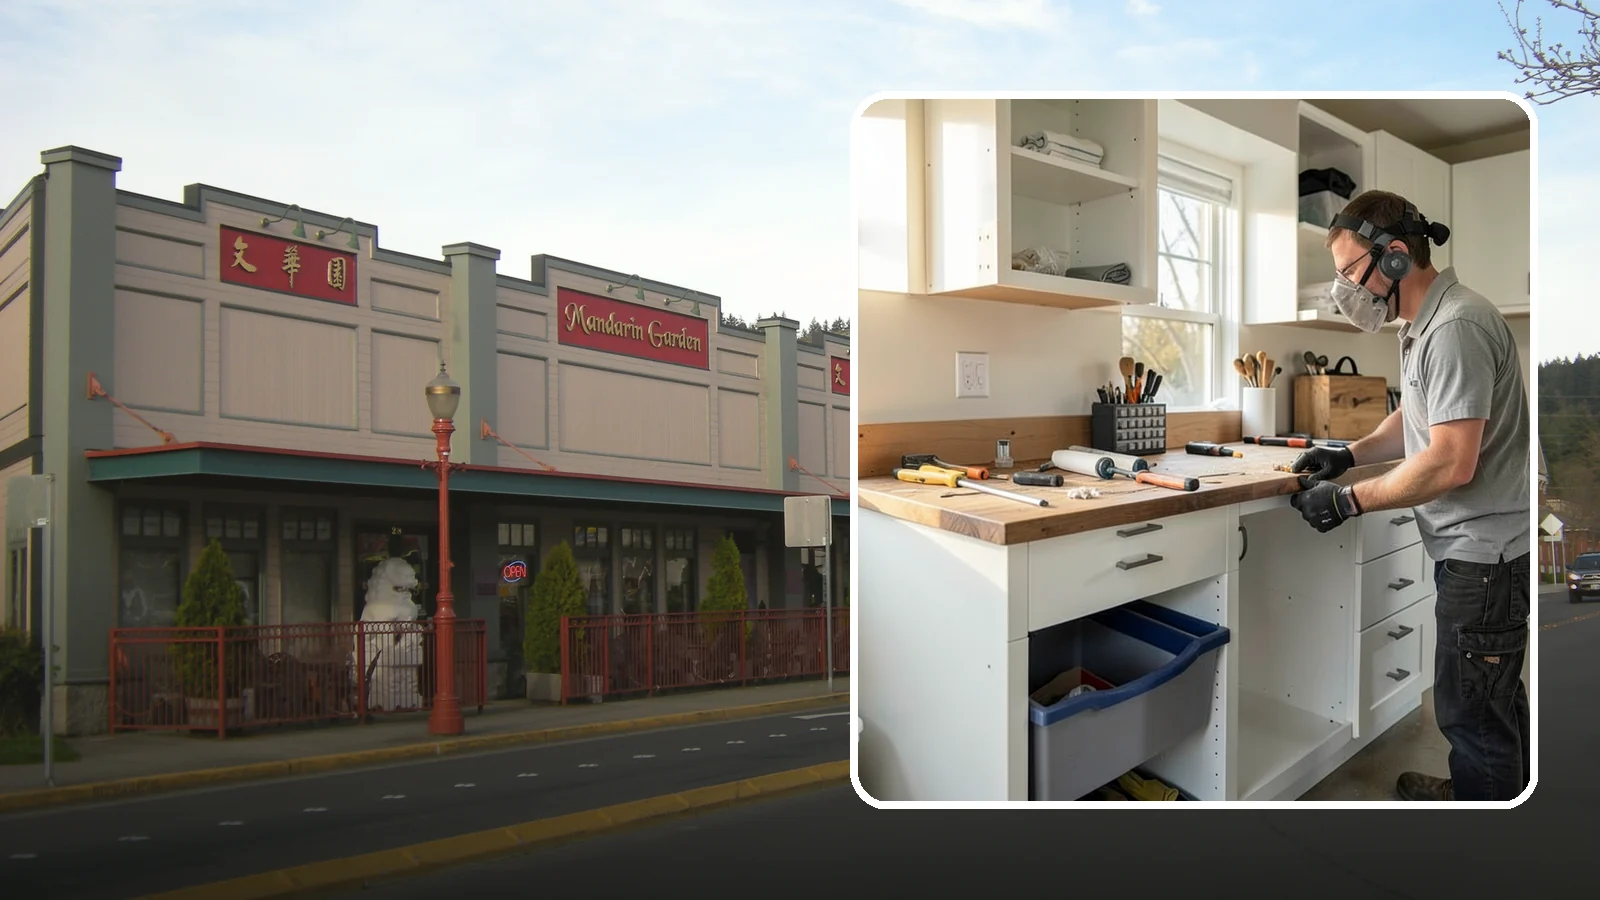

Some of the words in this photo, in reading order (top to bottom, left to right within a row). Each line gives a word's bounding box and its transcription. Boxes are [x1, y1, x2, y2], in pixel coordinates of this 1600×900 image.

[564, 302, 644, 341] Mandarin
[648, 320, 702, 352] Garden
[503, 565, 527, 578] OPEN
